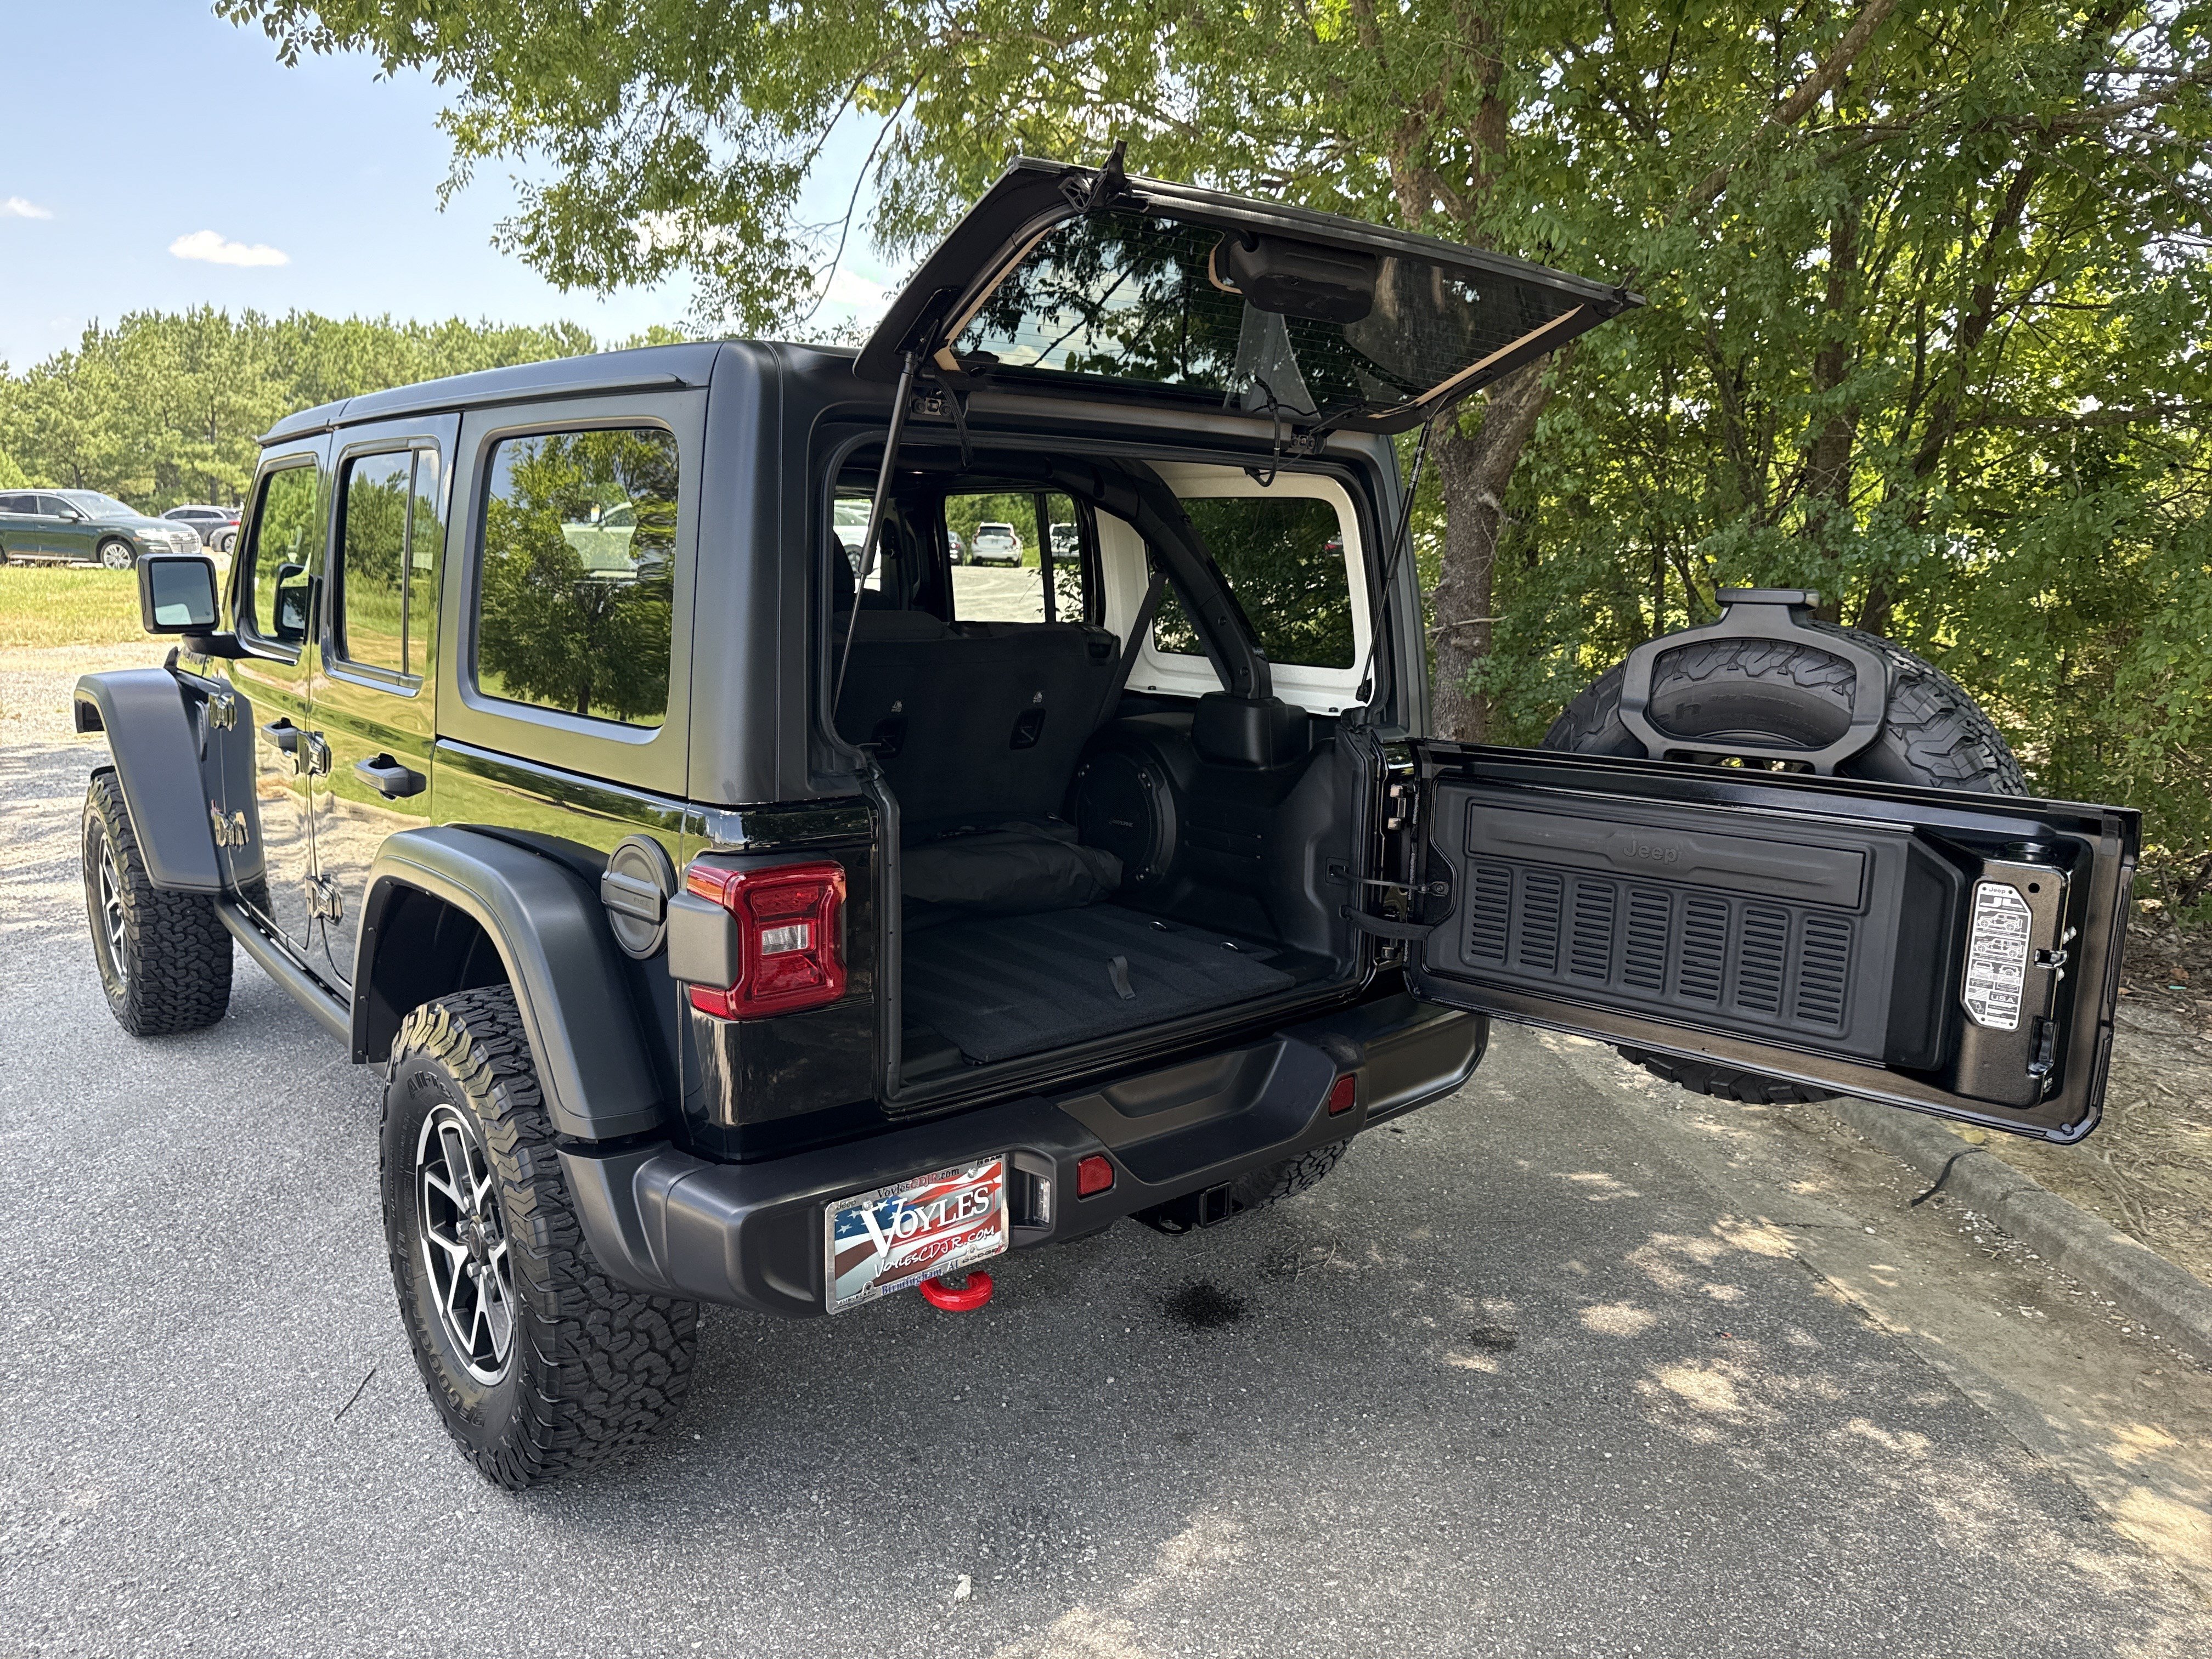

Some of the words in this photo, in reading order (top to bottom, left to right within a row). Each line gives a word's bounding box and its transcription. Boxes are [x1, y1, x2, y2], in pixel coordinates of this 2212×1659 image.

[1623, 839, 1678, 865] Jeep
[1991, 994, 2016, 1004] USA
[984, 1154, 1002, 1163] RAM
[877, 1167, 960, 1198] VoylesCDJR.com
[836, 1199, 856, 1210] Jeep
[860, 1187, 989, 1259] VOYLES
[881, 1267, 944, 1296] Birmingham,
